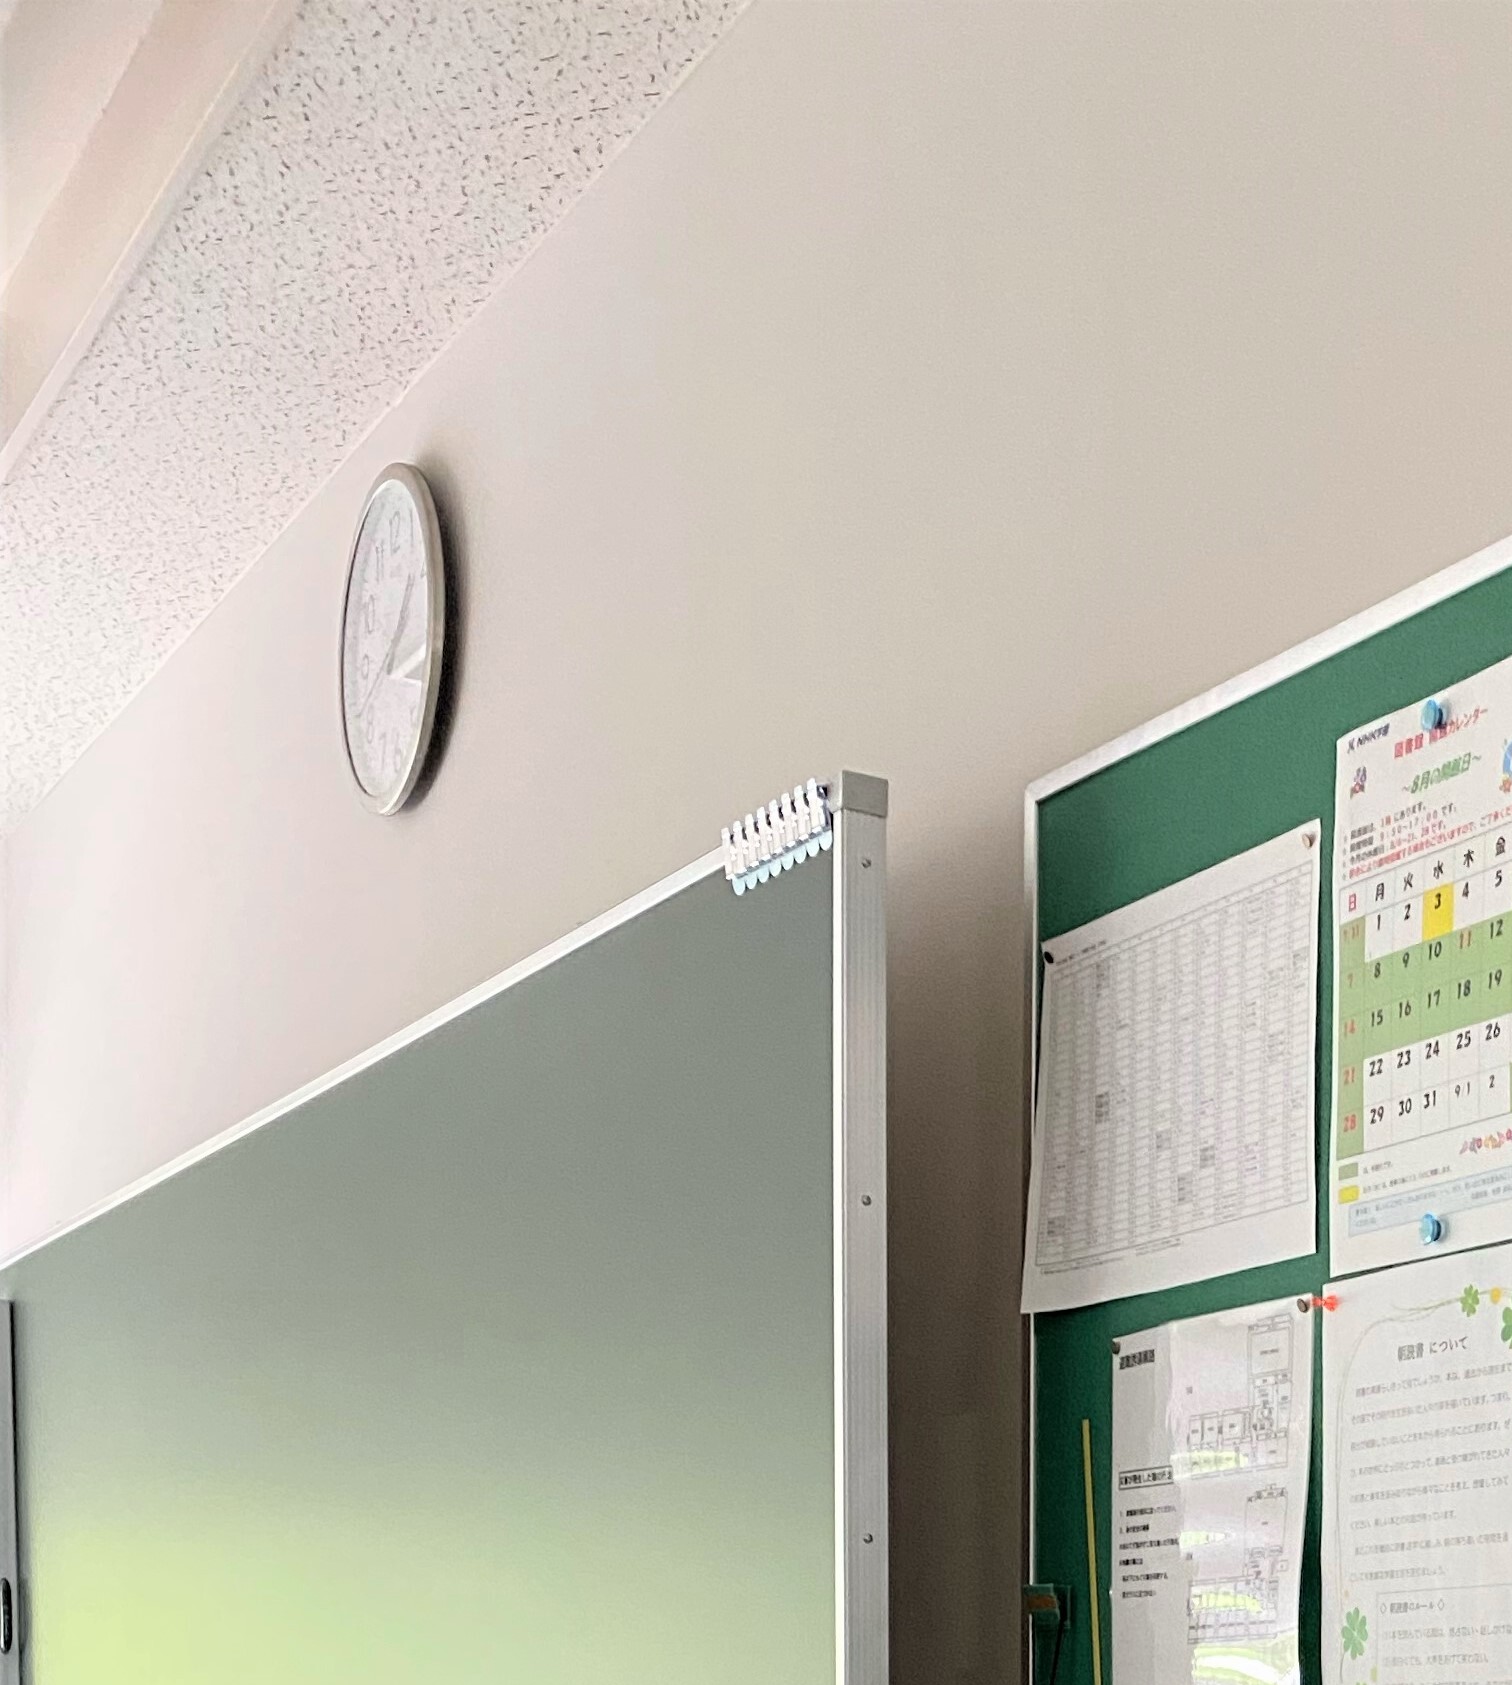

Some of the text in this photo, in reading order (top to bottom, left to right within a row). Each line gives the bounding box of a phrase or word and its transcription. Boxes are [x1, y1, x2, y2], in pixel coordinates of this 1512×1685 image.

[1348, 893, 1357, 912] 日
[1375, 882, 1385, 902] 月
[1403, 872, 1414, 891] 火
[1433, 860, 1444, 880] 水
[1463, 849, 1474, 869] 木
[1495, 836, 1506, 857] 金
[1428, 941, 1442, 960] 10
[1459, 930, 1472, 949] 11
[1490, 919, 1503, 939] 12
[1371, 1009, 1383, 1027] 15
[1399, 1000, 1412, 1018] 16
[1427, 989, 1441, 1008] 17
[1457, 980, 1471, 999] 18
[1488, 969, 1503, 990] 19
[1369, 1058, 1383, 1077] 22
[1396, 1049, 1411, 1069] 23
[1425, 1040, 1440, 1060] 24
[1456, 1030, 1471, 1050] 25
[1485, 1021, 1501, 1042] 26
[1369, 1105, 1385, 1125] 29
[1398, 1098, 1412, 1117] 30
[1423, 1090, 1437, 1109] 31
[1429, 1336, 1468, 1354] について
